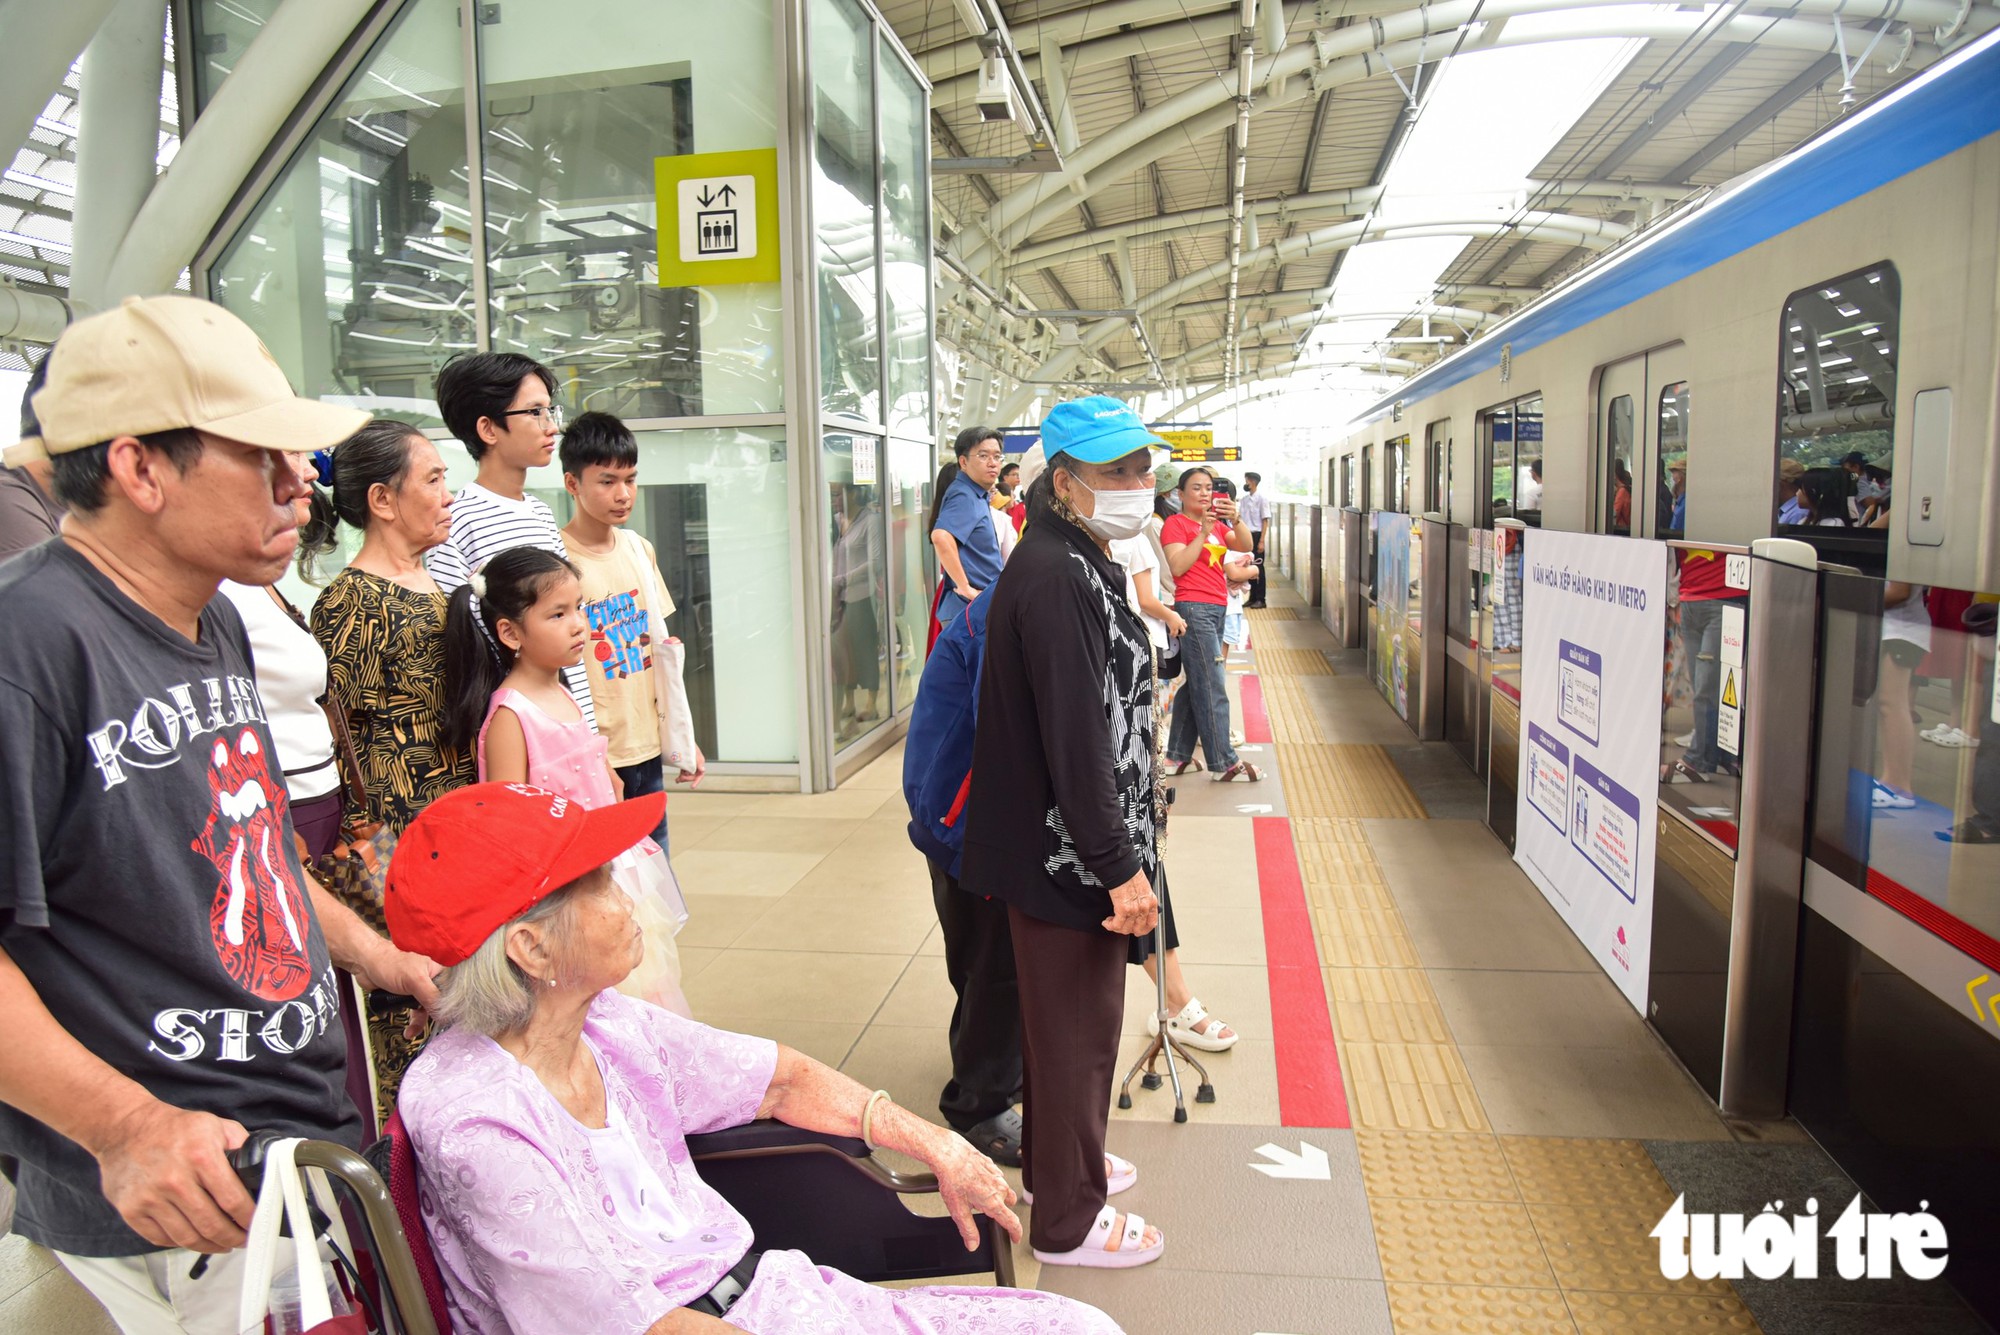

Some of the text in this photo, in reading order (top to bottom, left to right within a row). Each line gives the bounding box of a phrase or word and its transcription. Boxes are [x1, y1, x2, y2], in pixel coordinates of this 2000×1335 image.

[1532, 563, 1647, 611] VĂN HÓA XẾP HÀNG KHI ĐI METRO
[1729, 560, 1745, 585] 1-12
[602, 645, 646, 680] FIR
[148, 957, 341, 1062] STON
